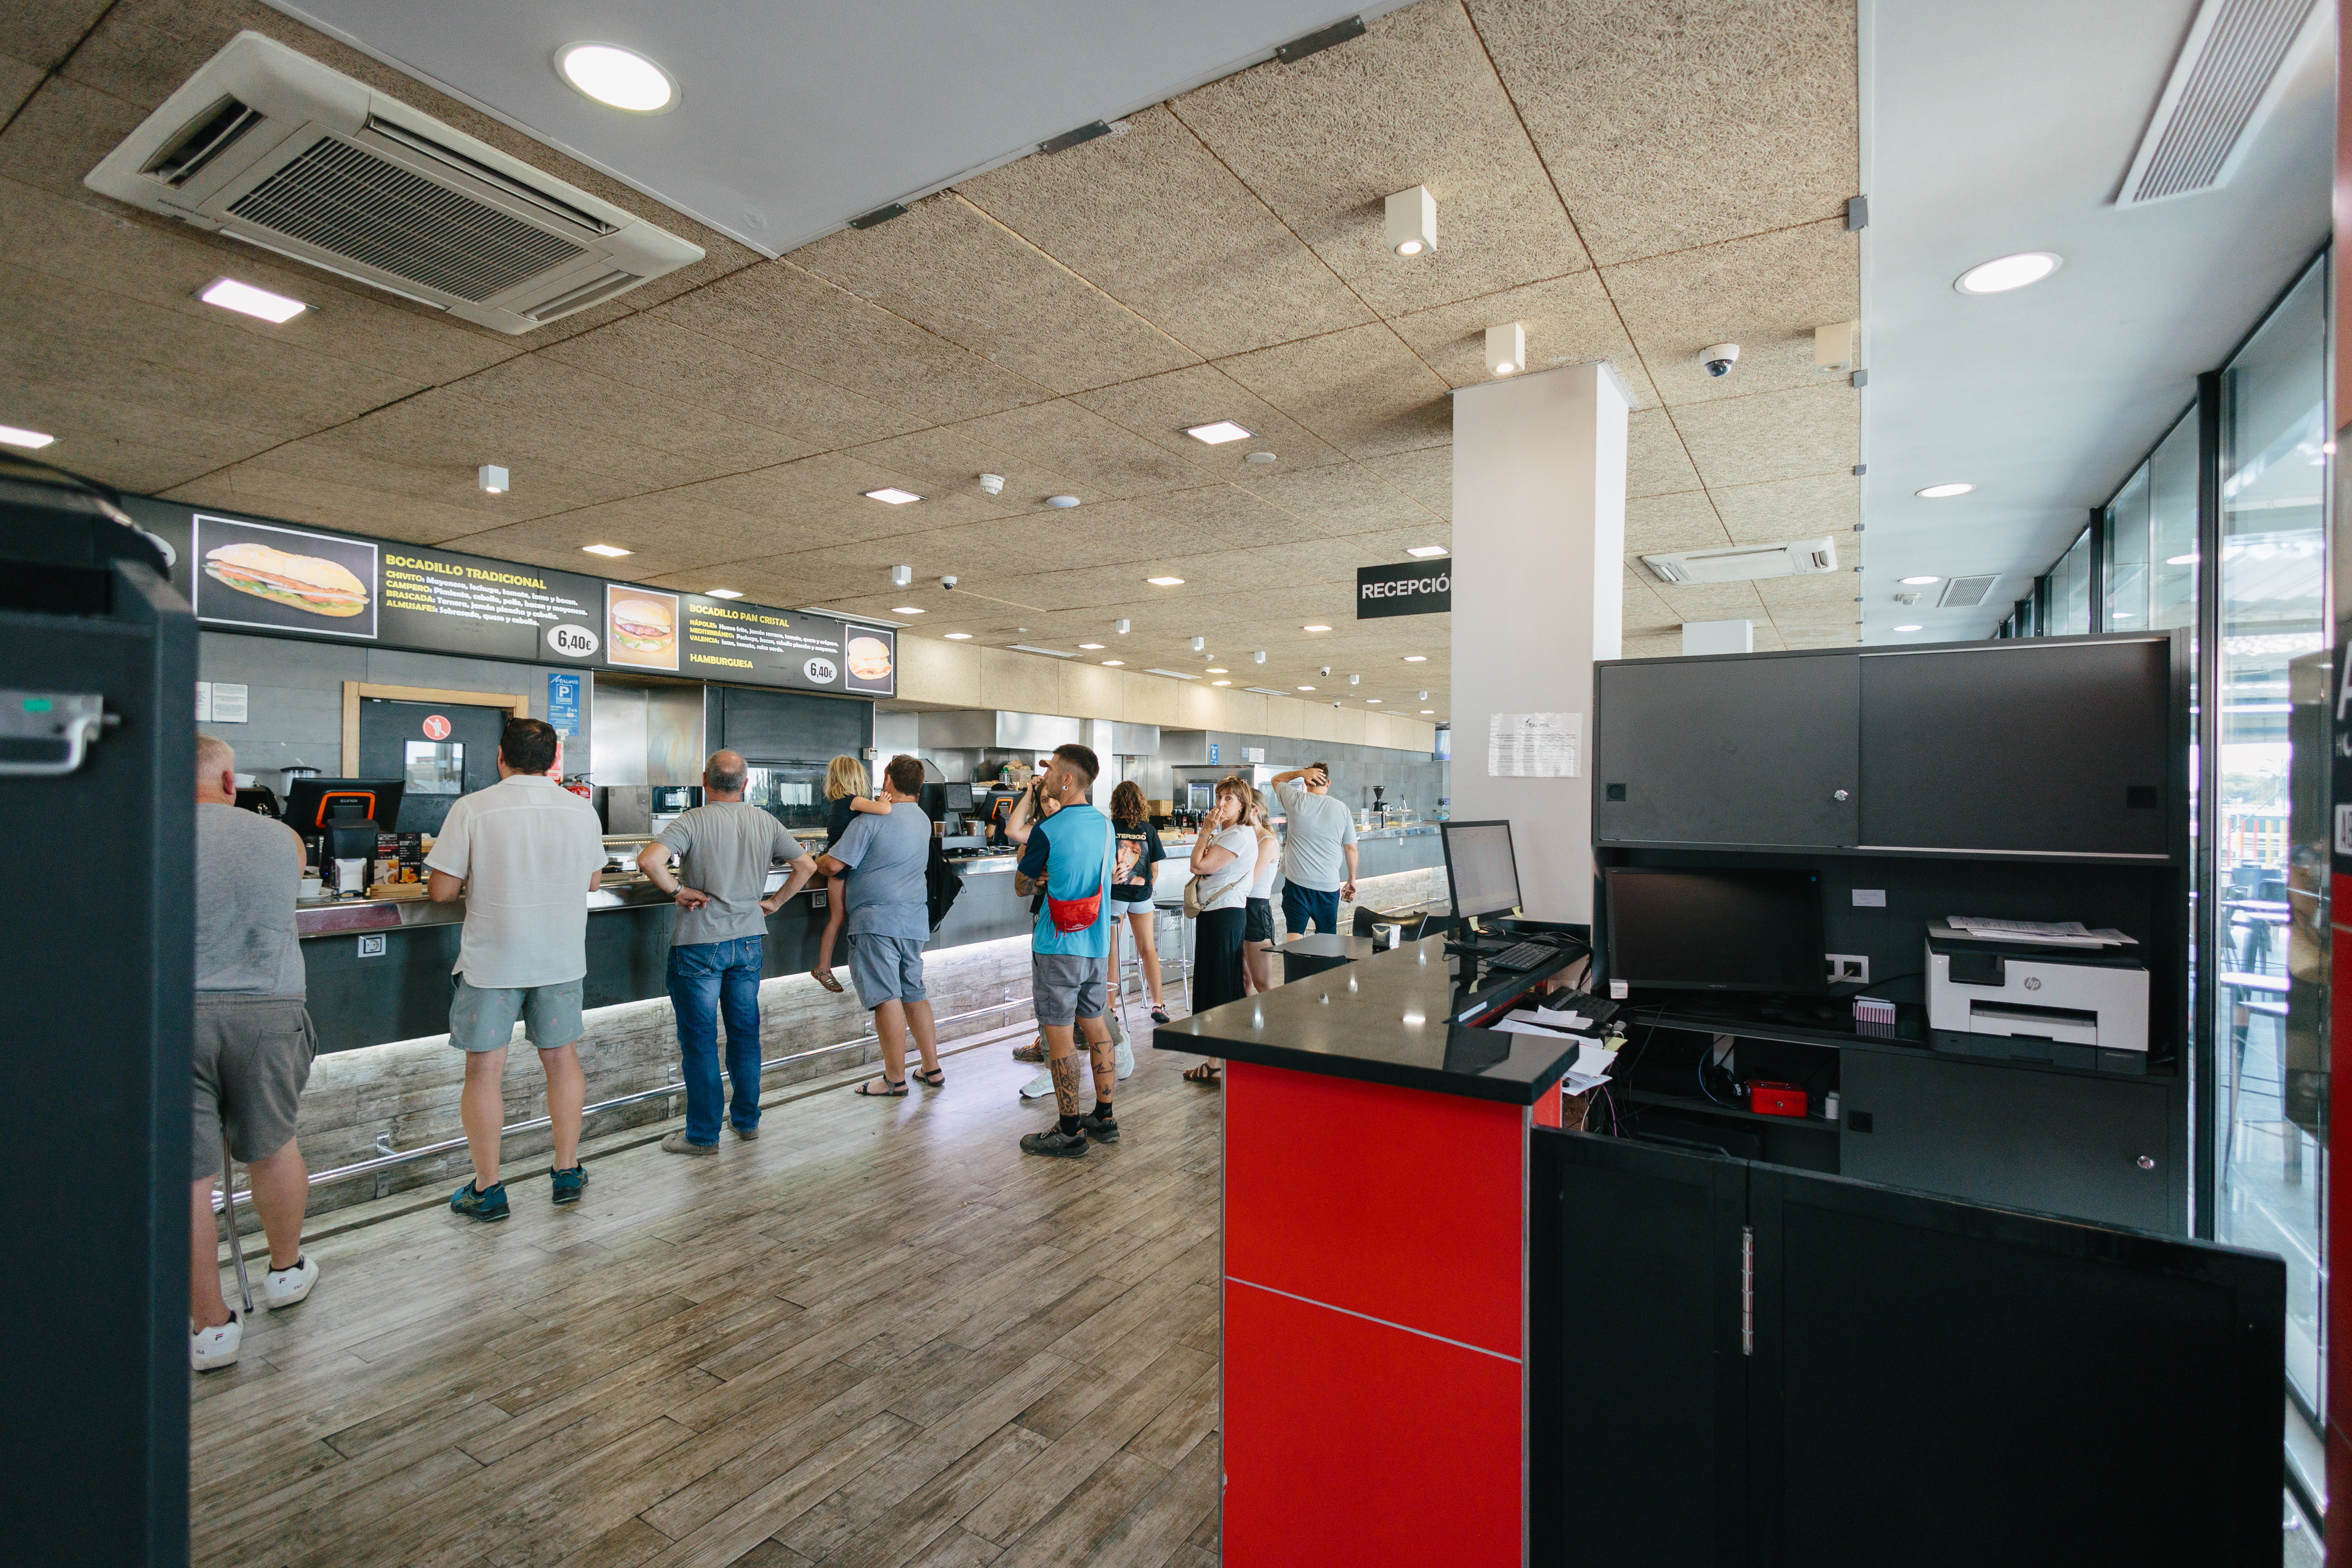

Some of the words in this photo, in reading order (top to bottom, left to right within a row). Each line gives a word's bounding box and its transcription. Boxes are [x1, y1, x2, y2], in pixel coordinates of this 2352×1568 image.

[386, 554, 463, 576] BOCADILLO
[466, 567, 547, 589] TRADICIONAL
[386, 570, 425, 583] CHIVITO:
[426, 576, 469, 590] Mayonesa,
[469, 583, 501, 595] lechuga,
[502, 588, 531, 599] tomate,
[532, 593, 549, 601] lomo
[556, 596, 578, 606] bacon.
[386, 580, 432, 593] CAMPERO:
[433, 587, 472, 600] Pimiento,
[473, 594, 502, 604] cebolla,
[503, 598, 523, 607] pollo,
[524, 600, 546, 609] bacon
[552, 605, 588, 616] mayonesa.
[1362, 573, 1452, 599] RECEPCIÓ
[386, 589, 436, 603] BRASCADA:
[436, 597, 470, 609] Ternera,
[471, 602, 495, 611] jamón
[496, 606, 525, 616] plancha
[532, 611, 559, 620] cebolla.
[386, 600, 438, 613] ALMUSAFES:
[439, 606, 482, 619] Sobrasada,
[482, 614, 505, 622] queso
[511, 617, 540, 627] cebolla.
[689, 604, 738, 619] BOCADILLO
[740, 612, 758, 622] PAN
[759, 615, 790, 628] CRISTAL
[558, 630, 591, 650] 6,40€
[689, 619, 717, 629] NÁPOLES:
[719, 623, 736, 632] Huevo
[784, 634, 803, 642] tomate,
[689, 627, 734, 639] MEDITERRÁNEO:
[736, 634, 759, 643] Pechuga,
[689, 635, 720, 644] VALENCIA:
[736, 641, 756, 649] tomate,
[689, 653, 753, 669] HAMBURGUESA
[811, 662, 833, 678] 6,40€
